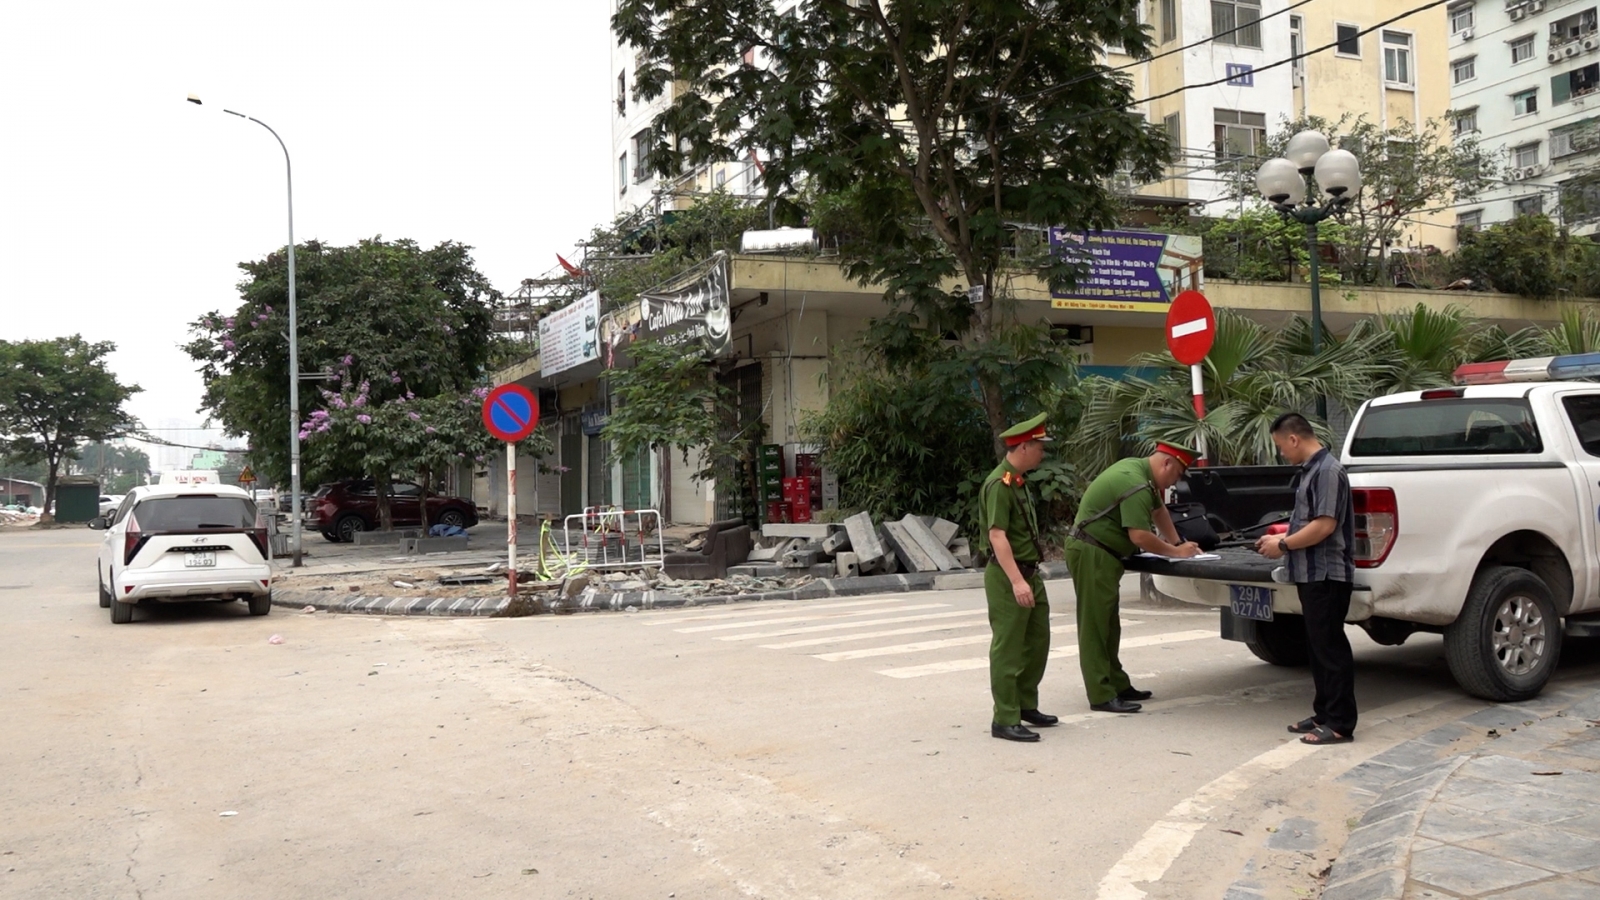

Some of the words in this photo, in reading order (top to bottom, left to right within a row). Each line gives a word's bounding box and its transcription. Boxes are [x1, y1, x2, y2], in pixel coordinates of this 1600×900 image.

[1231, 67, 1249, 84] N1
[1238, 586, 1260, 602] 29A
[1232, 600, 1270, 619] 027.40
